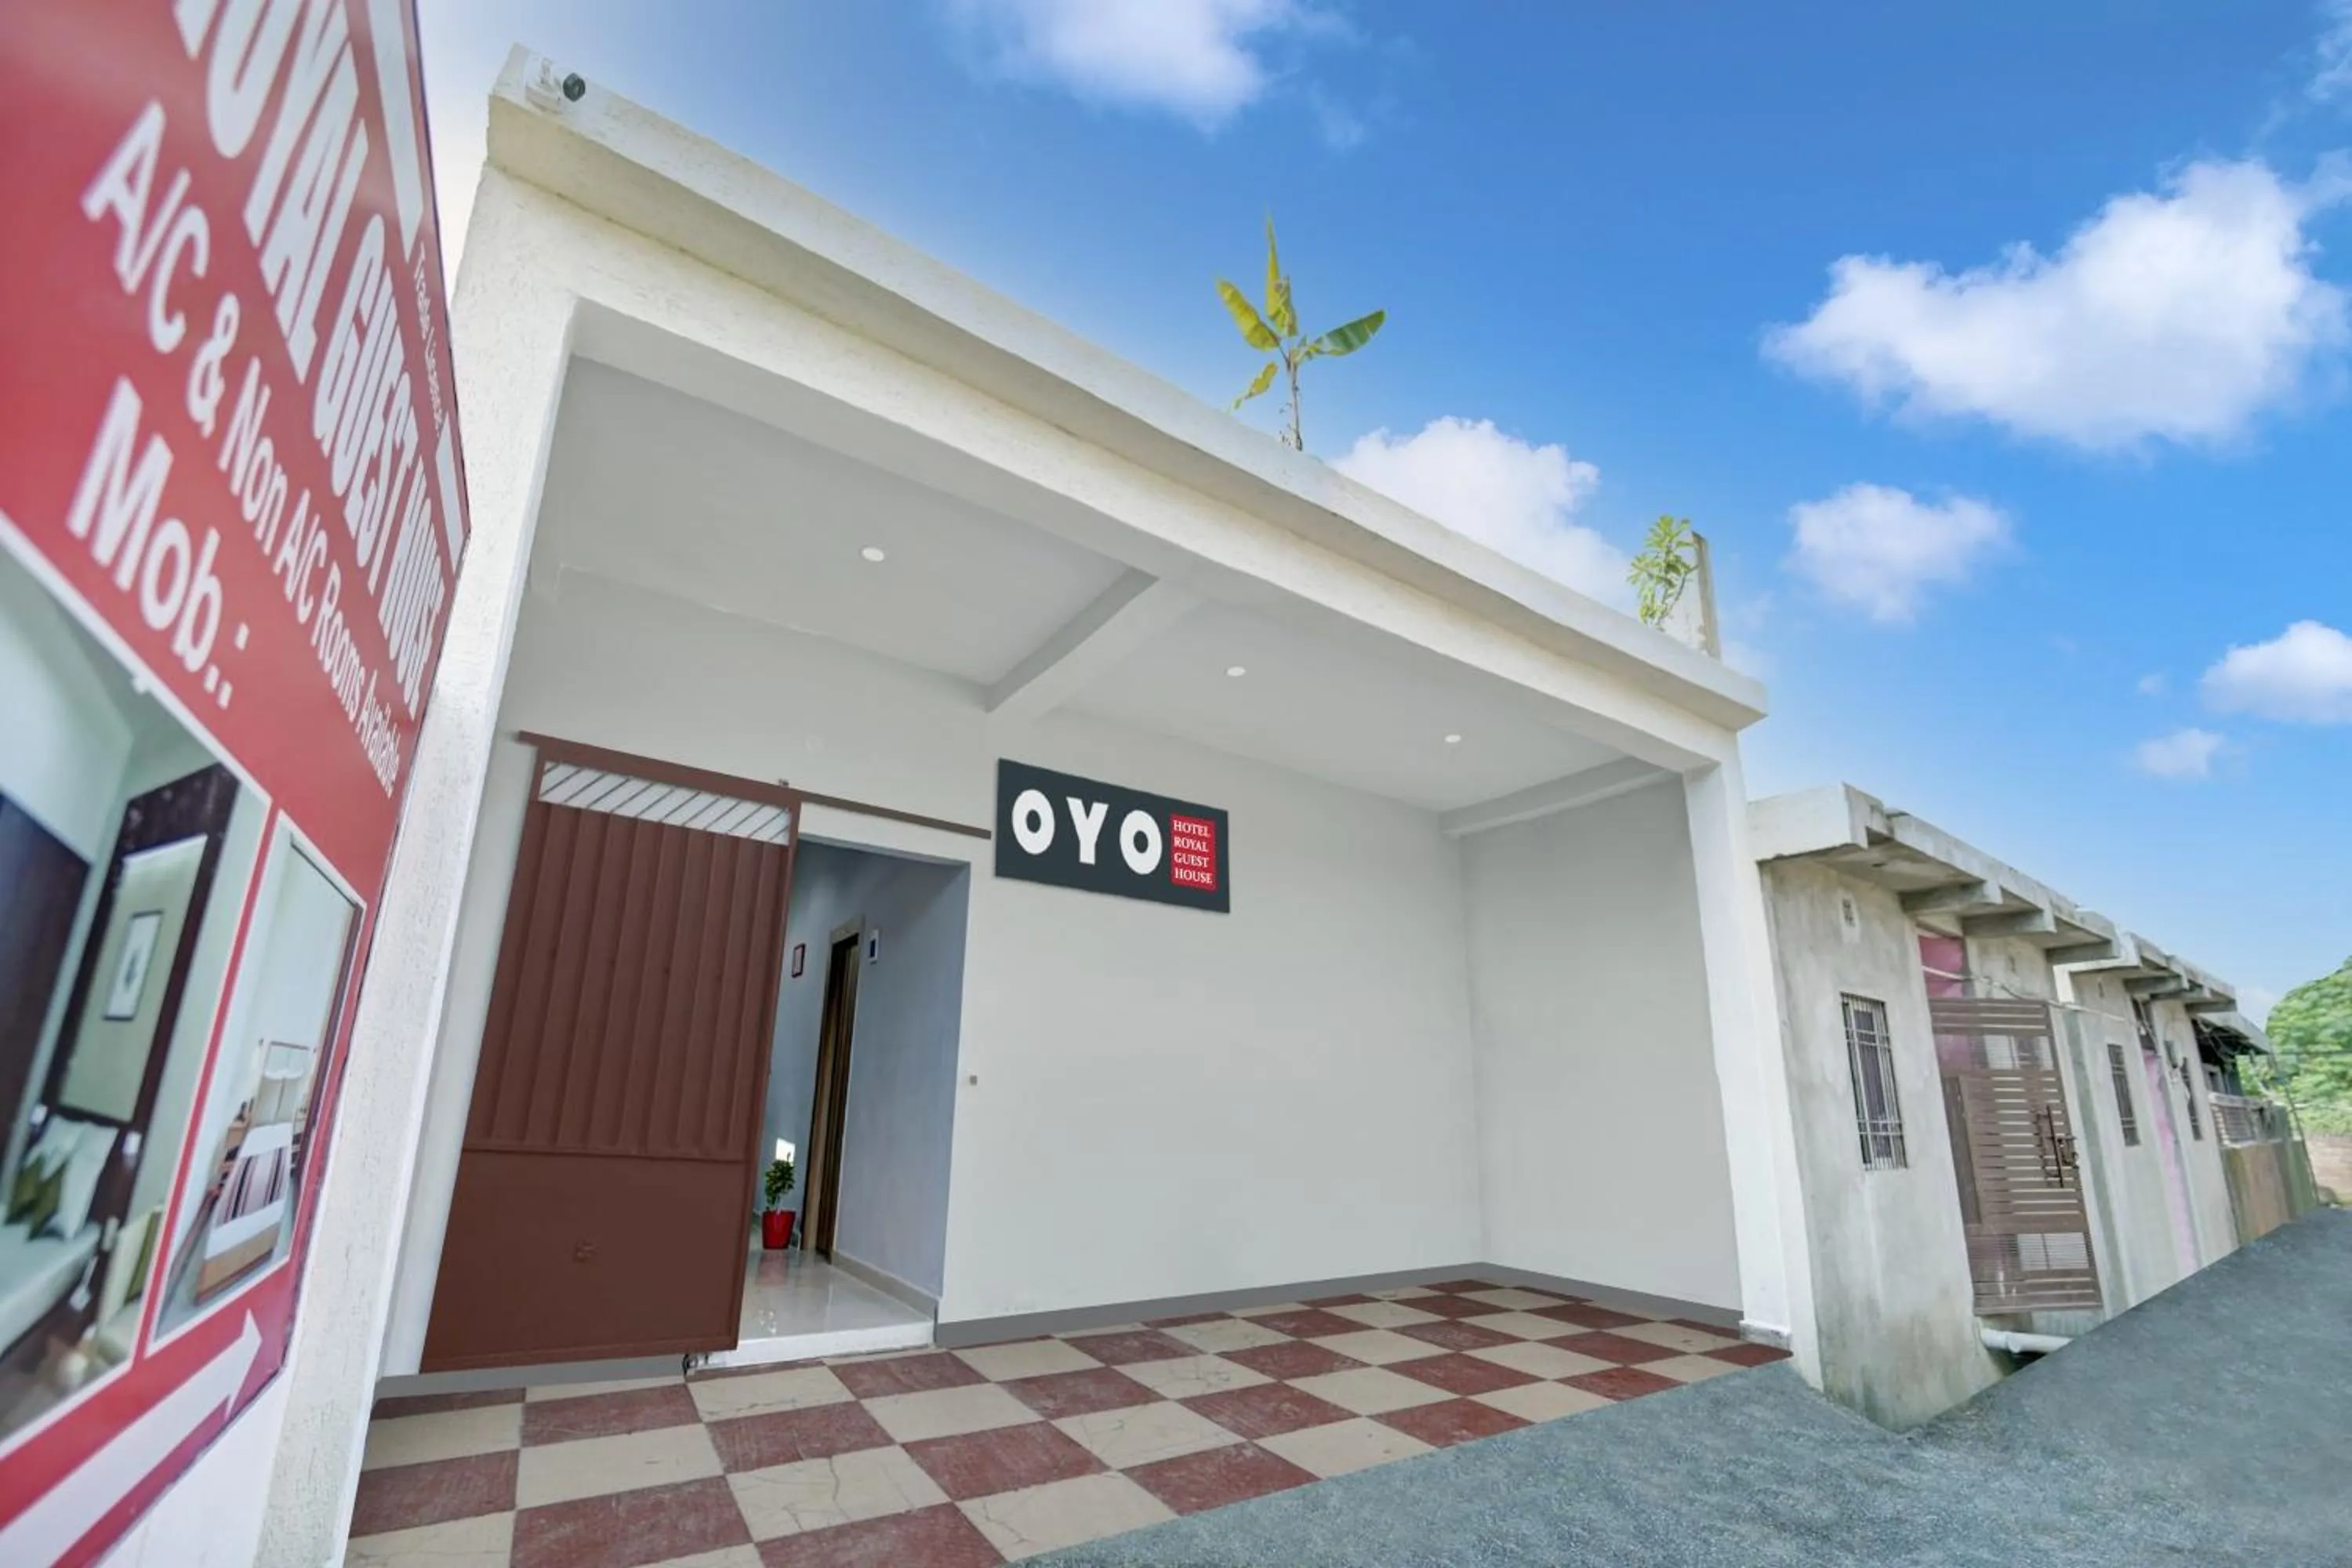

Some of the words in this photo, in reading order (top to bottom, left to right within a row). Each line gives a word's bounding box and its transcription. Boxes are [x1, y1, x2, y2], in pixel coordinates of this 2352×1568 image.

[81, 100, 210, 354] A/C
[186, 292, 240, 438] &
[217, 356, 288, 556] Non
[272, 488, 327, 625] A/C
[310, 561, 366, 724] Rooms
[313, 213, 419, 597] GUEST
[378, 455, 445, 721] HOUSE
[1011, 789, 1163, 875] OYO
[1173, 820, 1211, 837] HOTEL
[1173, 837, 1210, 853] ROYAL
[1174, 852, 1210, 868] GUEST
[1174, 867, 1213, 884] HOUSE
